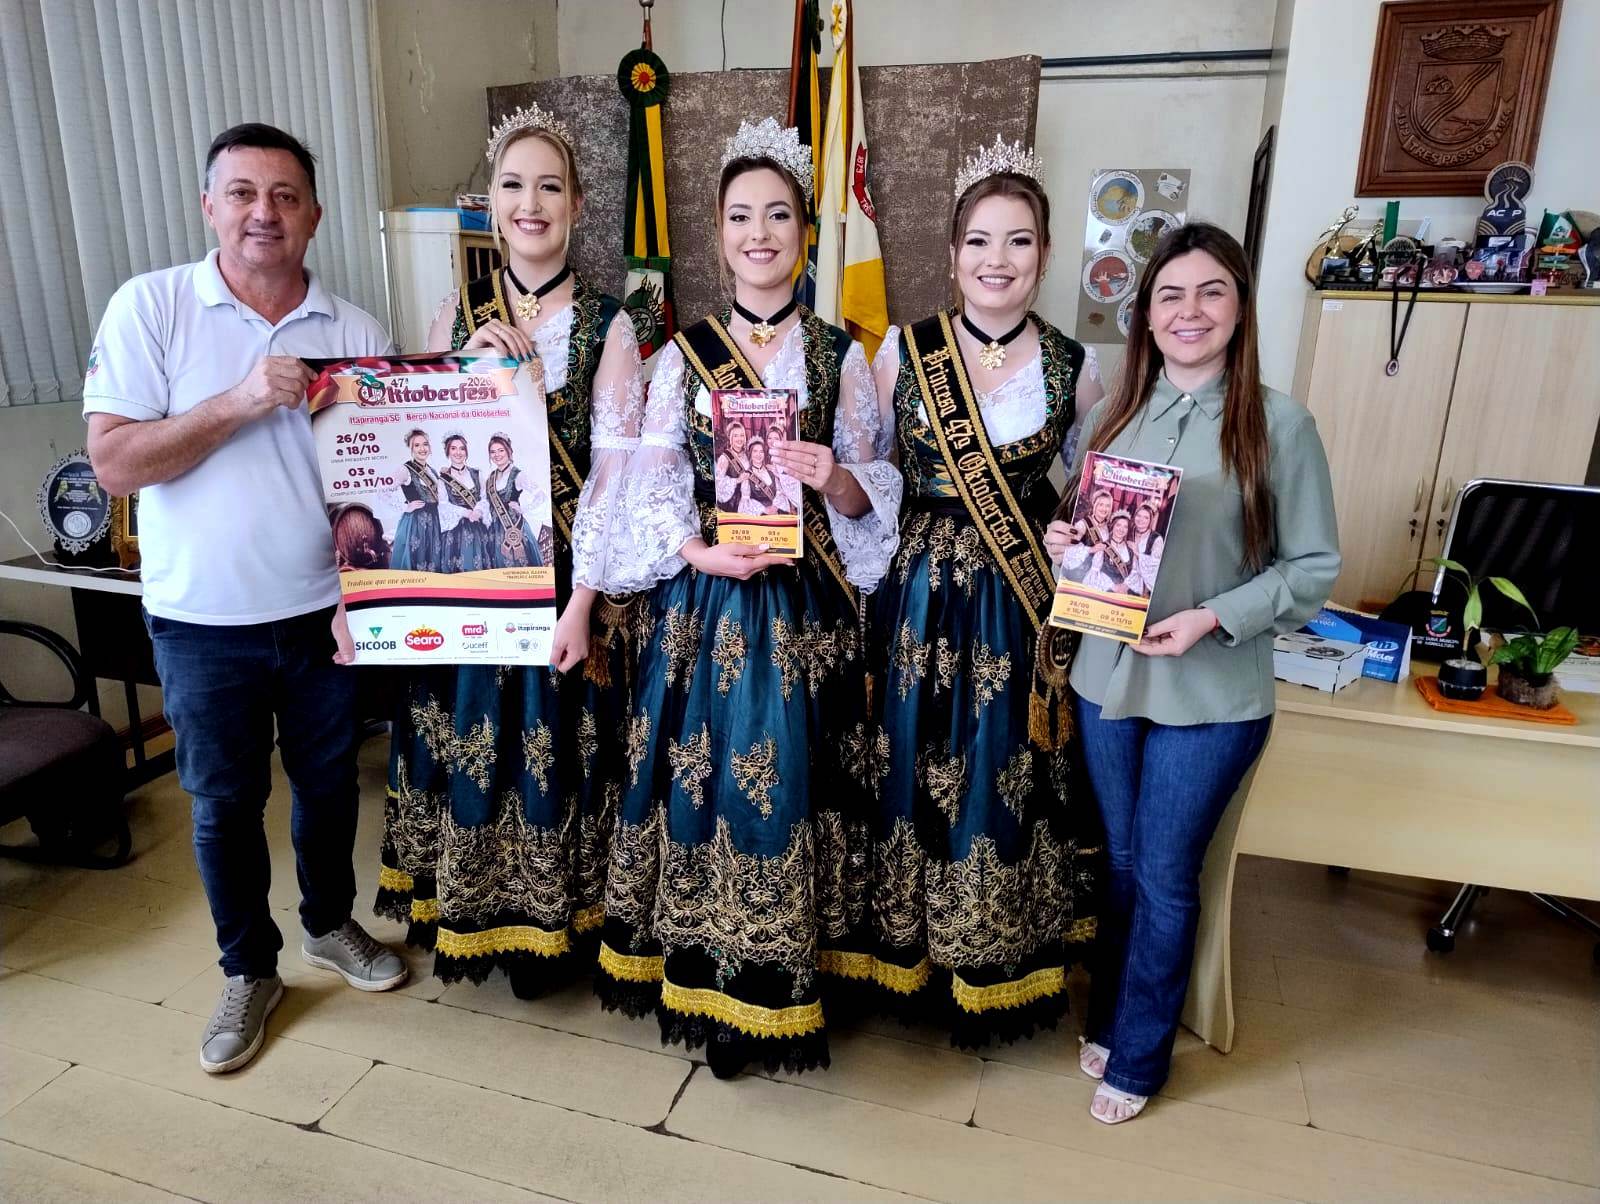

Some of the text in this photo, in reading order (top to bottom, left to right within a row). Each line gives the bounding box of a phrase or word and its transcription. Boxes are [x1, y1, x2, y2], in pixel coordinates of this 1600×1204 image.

[1441, 139, 1496, 164] PASSOS
[357, 381, 498, 406] Oktoberfest
[429, 411, 459, 420] Nacional
[471, 409, 510, 418] Oktoberfest
[336, 433, 376, 444] 26/09
[346, 444, 380, 455] 18/10
[923, 346, 958, 418] Princesa
[957, 451, 1023, 551] Oktoberfest
[348, 468, 365, 477] 03
[333, 480, 350, 489] 09
[363, 476, 394, 488] 11/10
[464, 626, 483, 634] mrd
[355, 640, 397, 651] SICOOB
[406, 635, 442, 646] Seara
